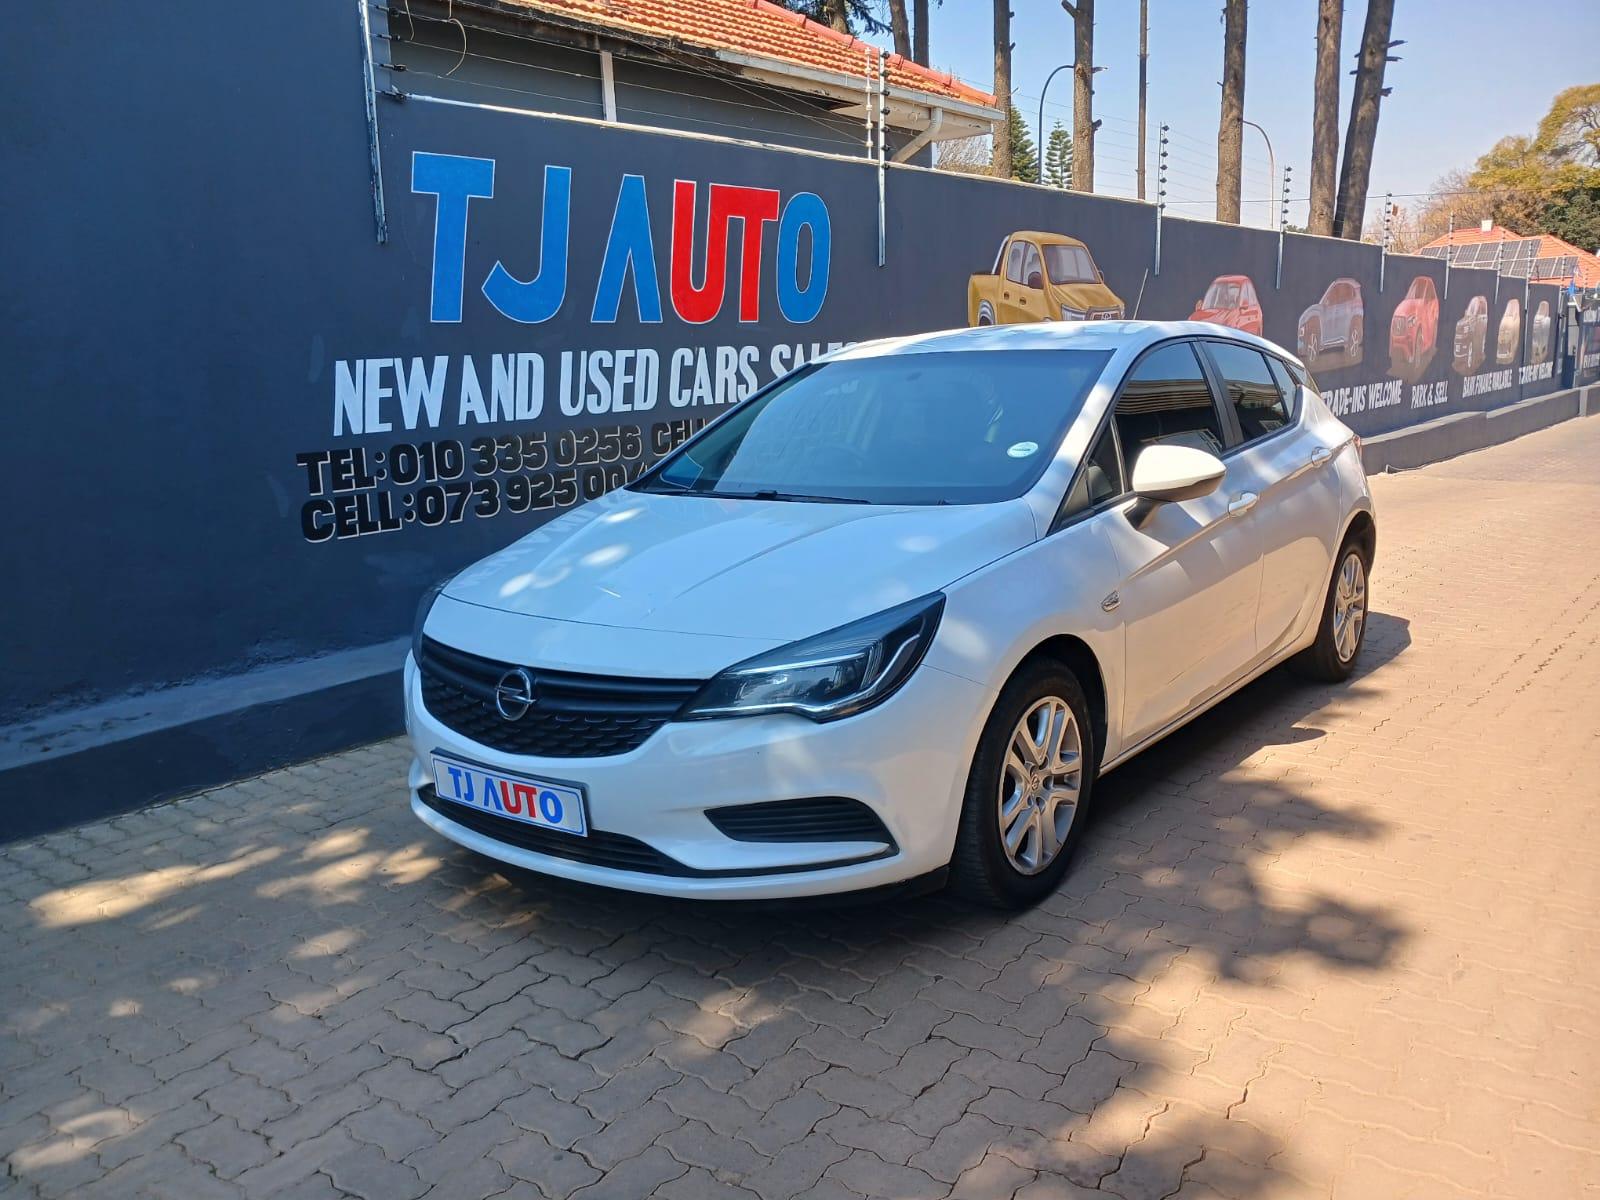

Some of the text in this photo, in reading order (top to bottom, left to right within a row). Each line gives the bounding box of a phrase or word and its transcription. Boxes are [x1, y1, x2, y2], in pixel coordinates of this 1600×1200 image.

[590, 173, 831, 324] AUTO
[333, 354, 449, 437] NEW
[458, 352, 545, 426] AND
[559, 348, 660, 418] USED
[669, 345, 760, 408] CARS
[1368, 379, 1402, 410] WELCOME
[1411, 384, 1428, 409] PARK
[1434, 380, 1448, 404] SELL
[296, 439, 464, 496] TEL:010
[470, 431, 548, 477] 335
[554, 424, 642, 467] 0256
[302, 478, 500, 543] CELL:073
[506, 468, 578, 514] 925
[447, 766, 564, 824] TJ AUTO
